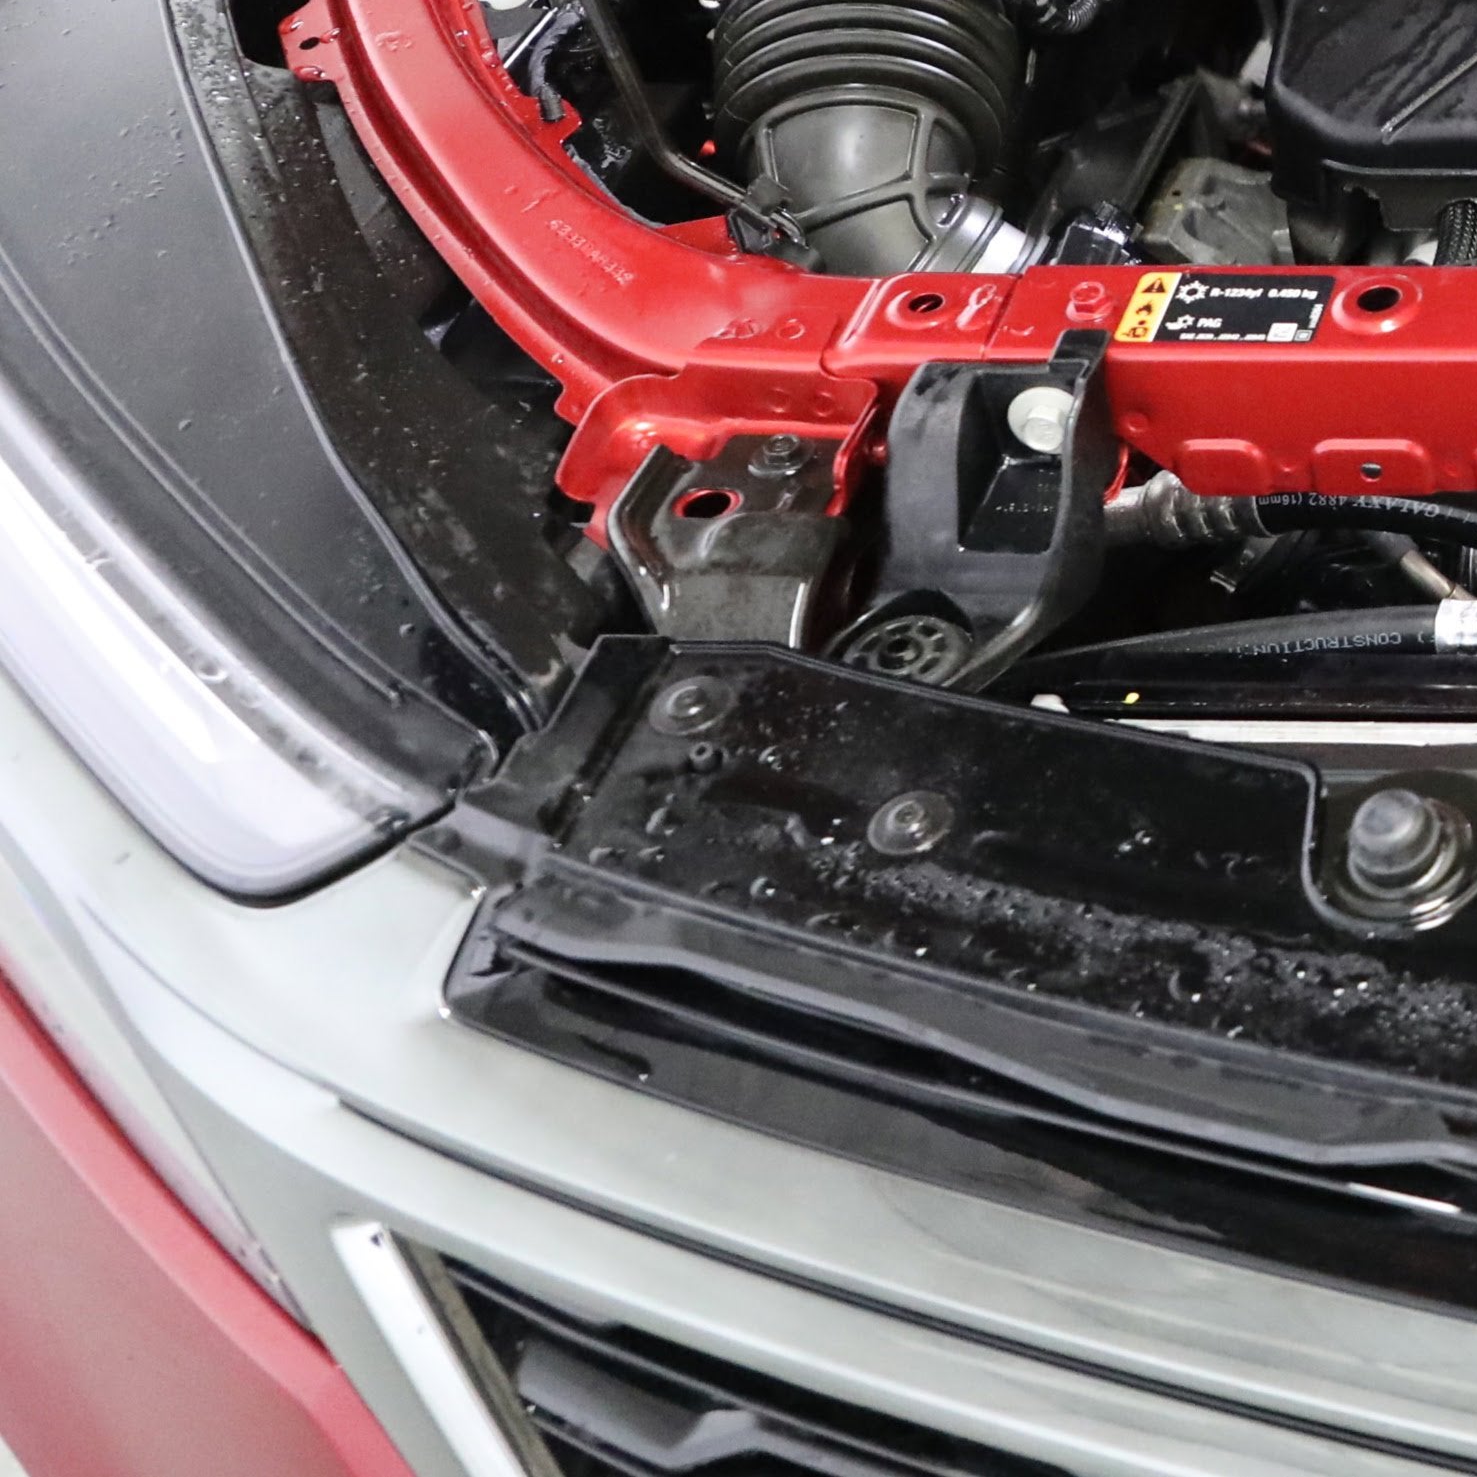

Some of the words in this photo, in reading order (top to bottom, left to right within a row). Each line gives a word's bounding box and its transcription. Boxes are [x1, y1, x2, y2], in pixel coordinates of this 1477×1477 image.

[1196, 317, 1223, 328] PAG
[1308, 491, 1349, 507] 4882
[1353, 495, 1441, 517] GALAXY
[1254, 631, 1403, 655] CONSTRUCTION
